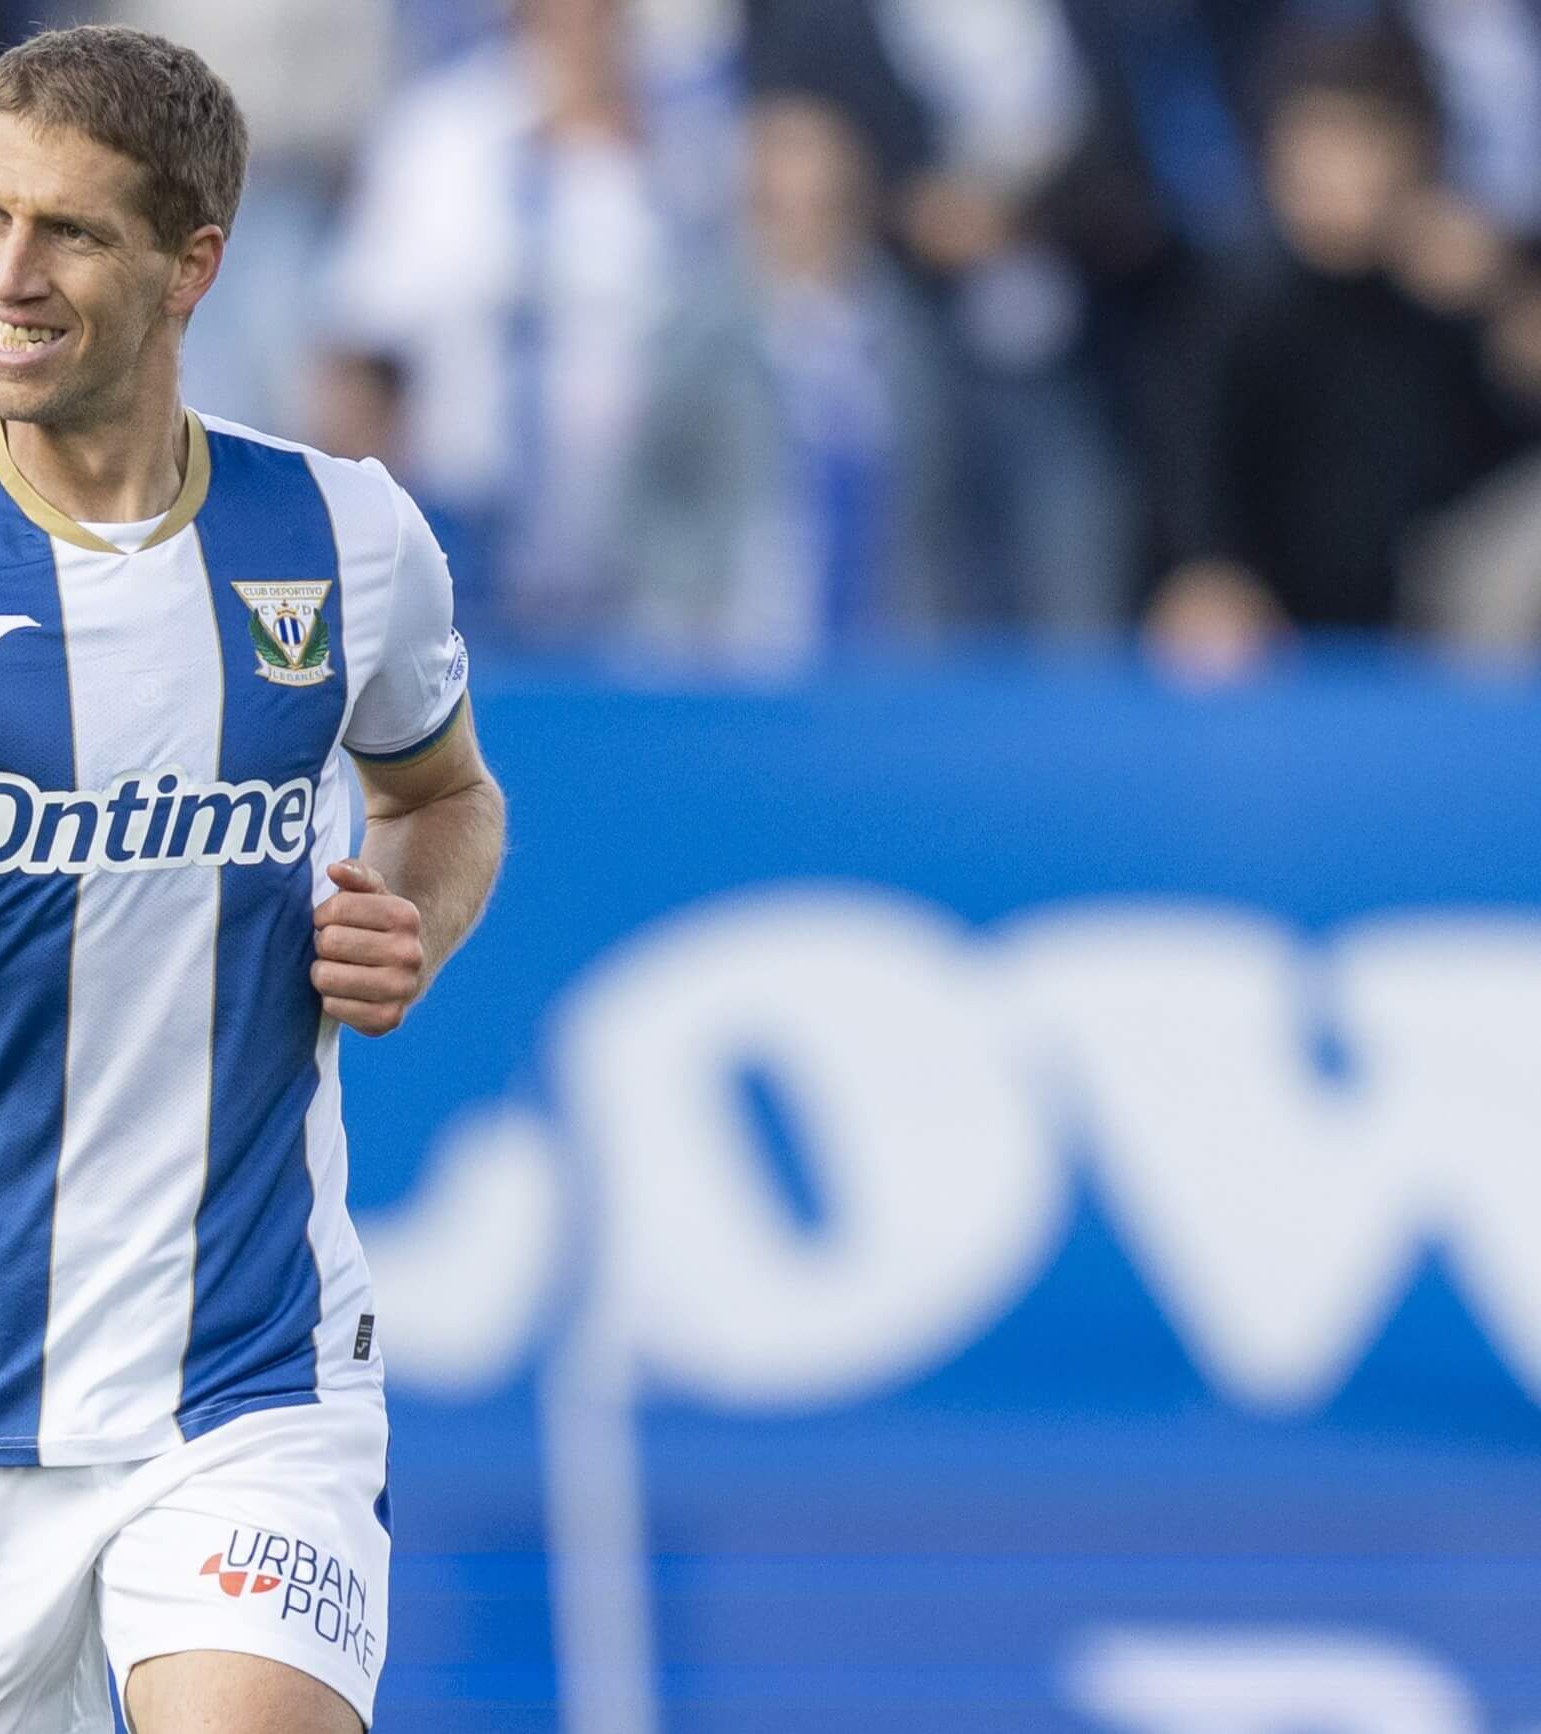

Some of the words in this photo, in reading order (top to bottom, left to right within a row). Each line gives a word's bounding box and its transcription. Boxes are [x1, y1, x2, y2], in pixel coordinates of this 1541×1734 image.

[243, 587, 268, 596] CLUB
[269, 586, 323, 596] DEPORTIVO
[226, 1529, 367, 1621] URBAN
[281, 1583, 376, 1678] POKE
